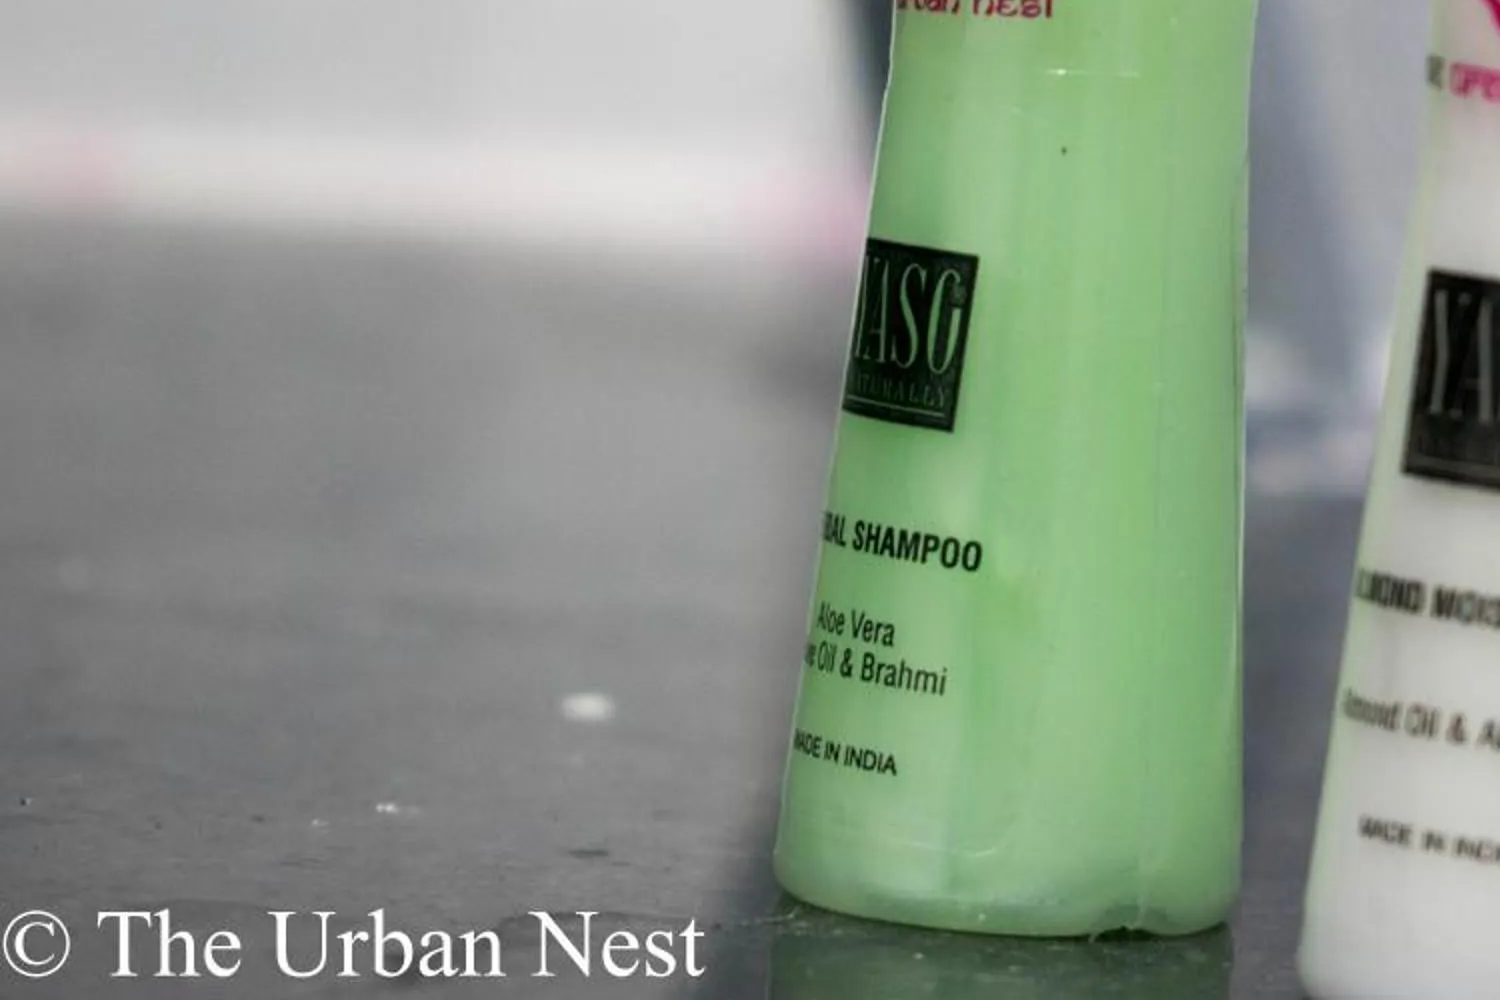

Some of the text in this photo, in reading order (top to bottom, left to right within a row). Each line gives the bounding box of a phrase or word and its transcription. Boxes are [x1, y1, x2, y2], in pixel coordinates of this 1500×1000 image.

[852, 520, 983, 572] SHAMPOO
[817, 601, 896, 647] Aloe Vera
[817, 640, 836, 674] Oil
[839, 647, 854, 679] &
[861, 650, 948, 696] Brahmi
[1445, 713, 1466, 745] &
[823, 740, 842, 763] IN
[843, 745, 898, 776] INDIA
